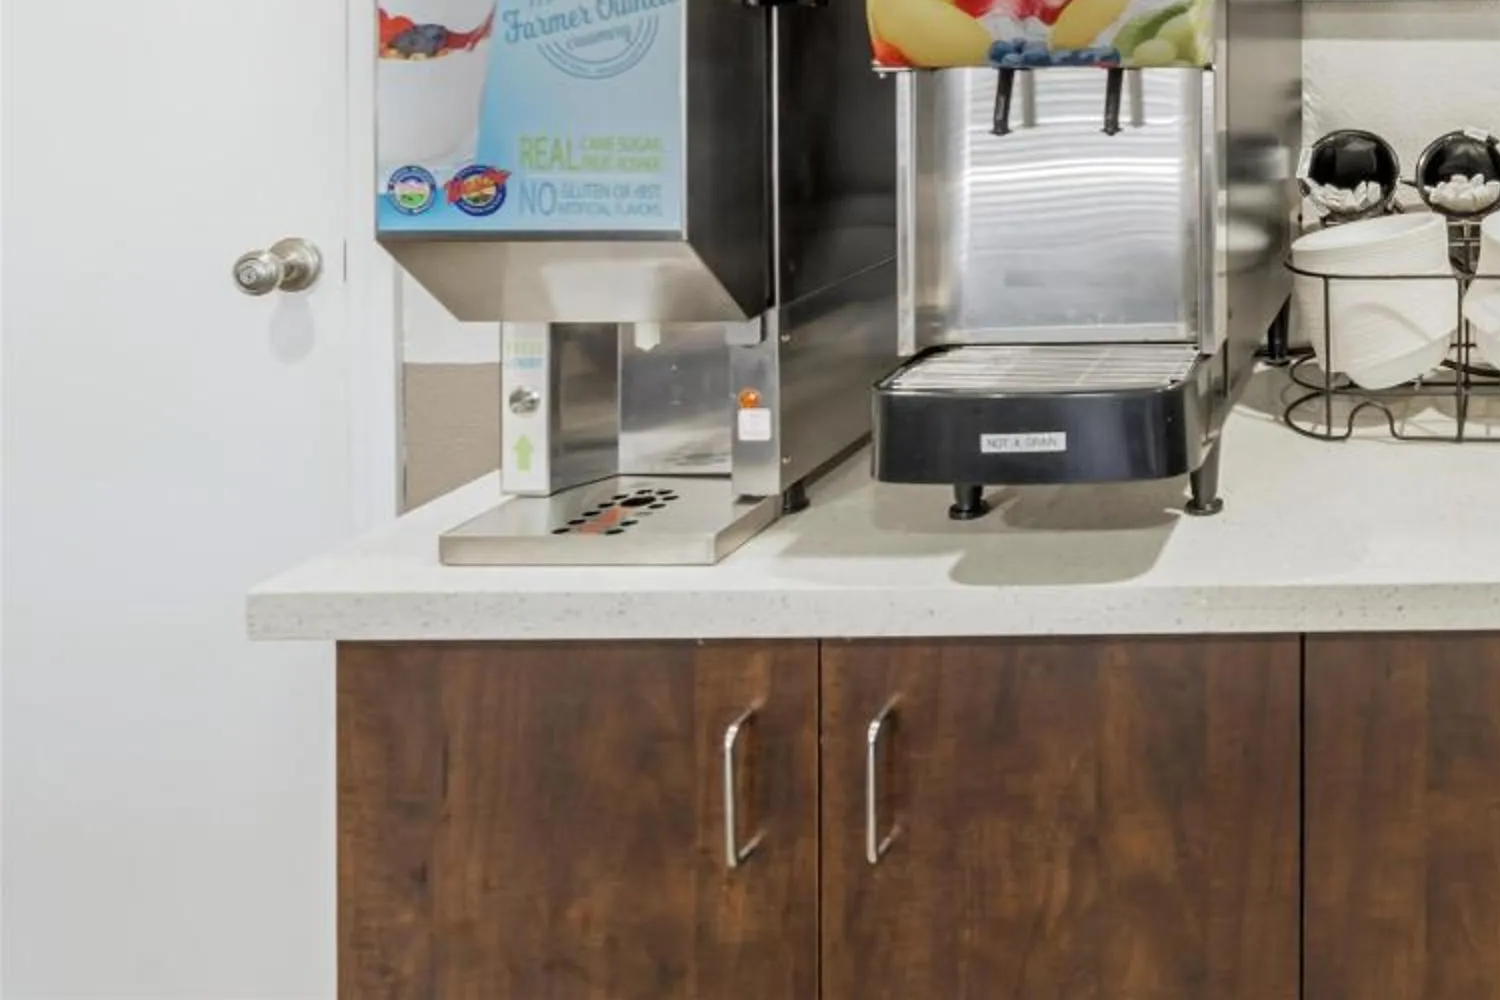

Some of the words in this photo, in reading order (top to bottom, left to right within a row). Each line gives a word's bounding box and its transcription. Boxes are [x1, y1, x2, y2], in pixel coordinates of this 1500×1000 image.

[502, 4, 591, 45] Farmer
[519, 135, 580, 171] REAL
[519, 181, 558, 217] NO
